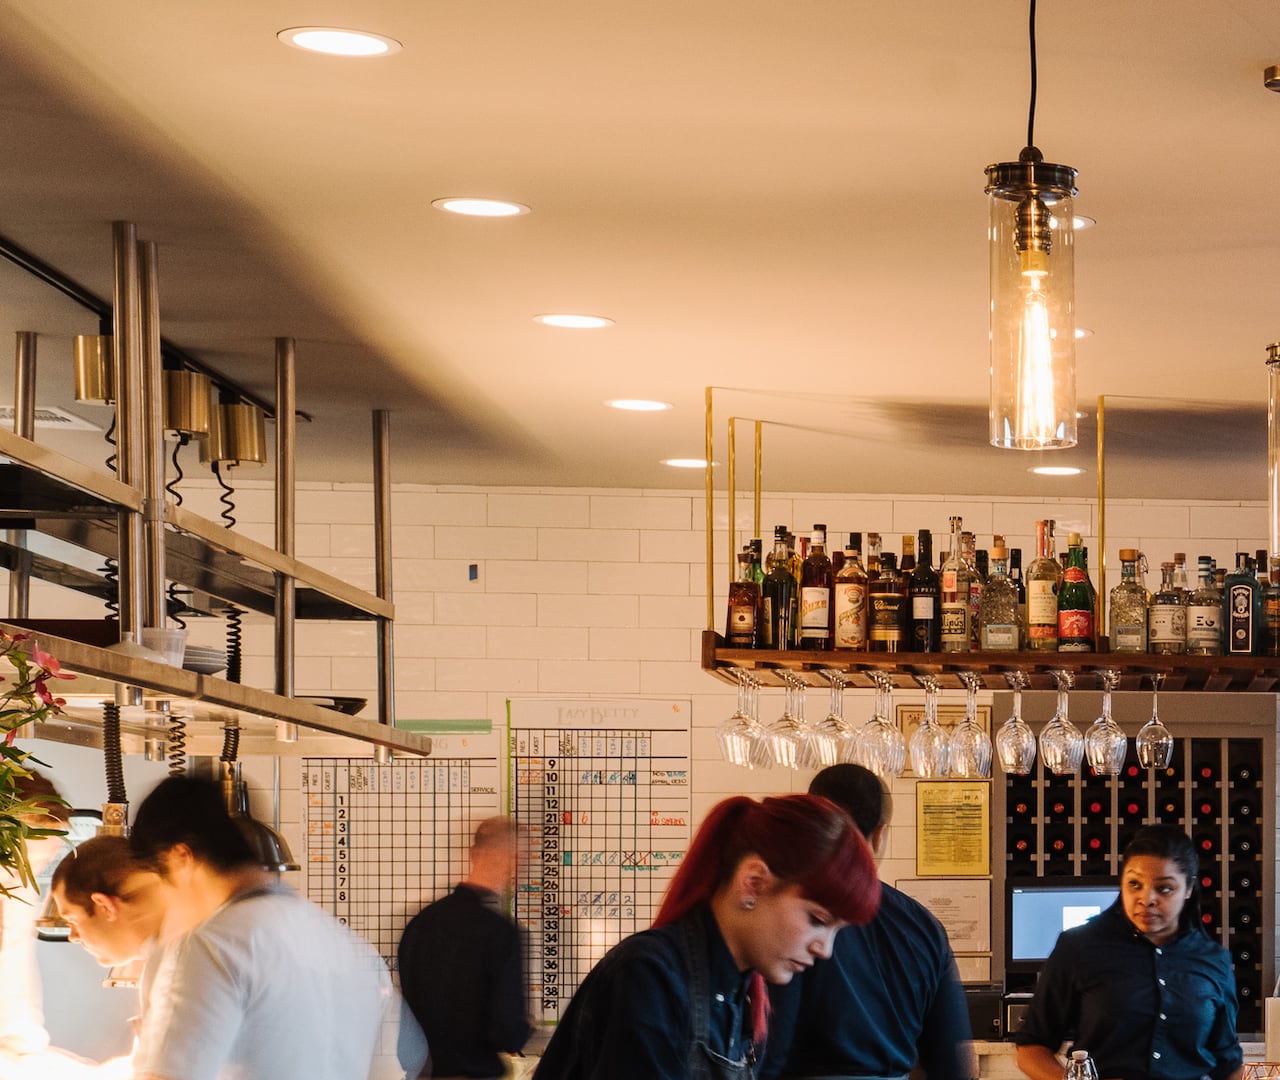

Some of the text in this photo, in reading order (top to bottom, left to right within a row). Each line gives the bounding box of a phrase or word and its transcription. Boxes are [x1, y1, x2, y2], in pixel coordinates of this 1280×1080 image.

[556, 706, 639, 726] LAZY BETTY
[549, 760, 556, 769] 9
[546, 772, 558, 782] 10
[546, 786, 556, 796] 11
[338, 796, 344, 805] 1
[546, 800, 558, 809] 12
[338, 810, 345, 819] 2
[546, 813, 557, 823] 21
[339, 823, 346, 832] 3
[544, 826, 558, 836] 22
[338, 837, 346, 846] 4
[544, 840, 558, 849] 23
[339, 850, 346, 859] 5
[545, 854, 558, 862] 24
[339, 864, 346, 873] 6
[544, 867, 558, 876] 25
[339, 878, 346, 887] 7
[544, 881, 558, 889] 26
[339, 891, 346, 901] 8
[544, 894, 556, 902] 31
[624, 895, 633, 904] 2
[545, 907, 558, 916] 32
[626, 908, 634, 917] 2
[544, 921, 558, 929] 33
[544, 934, 558, 942] 34
[544, 947, 557, 956] 35
[544, 960, 557, 969] 36
[544, 975, 557, 983] 37
[545, 987, 558, 996] 38
[544, 1000, 557, 1009] 27
